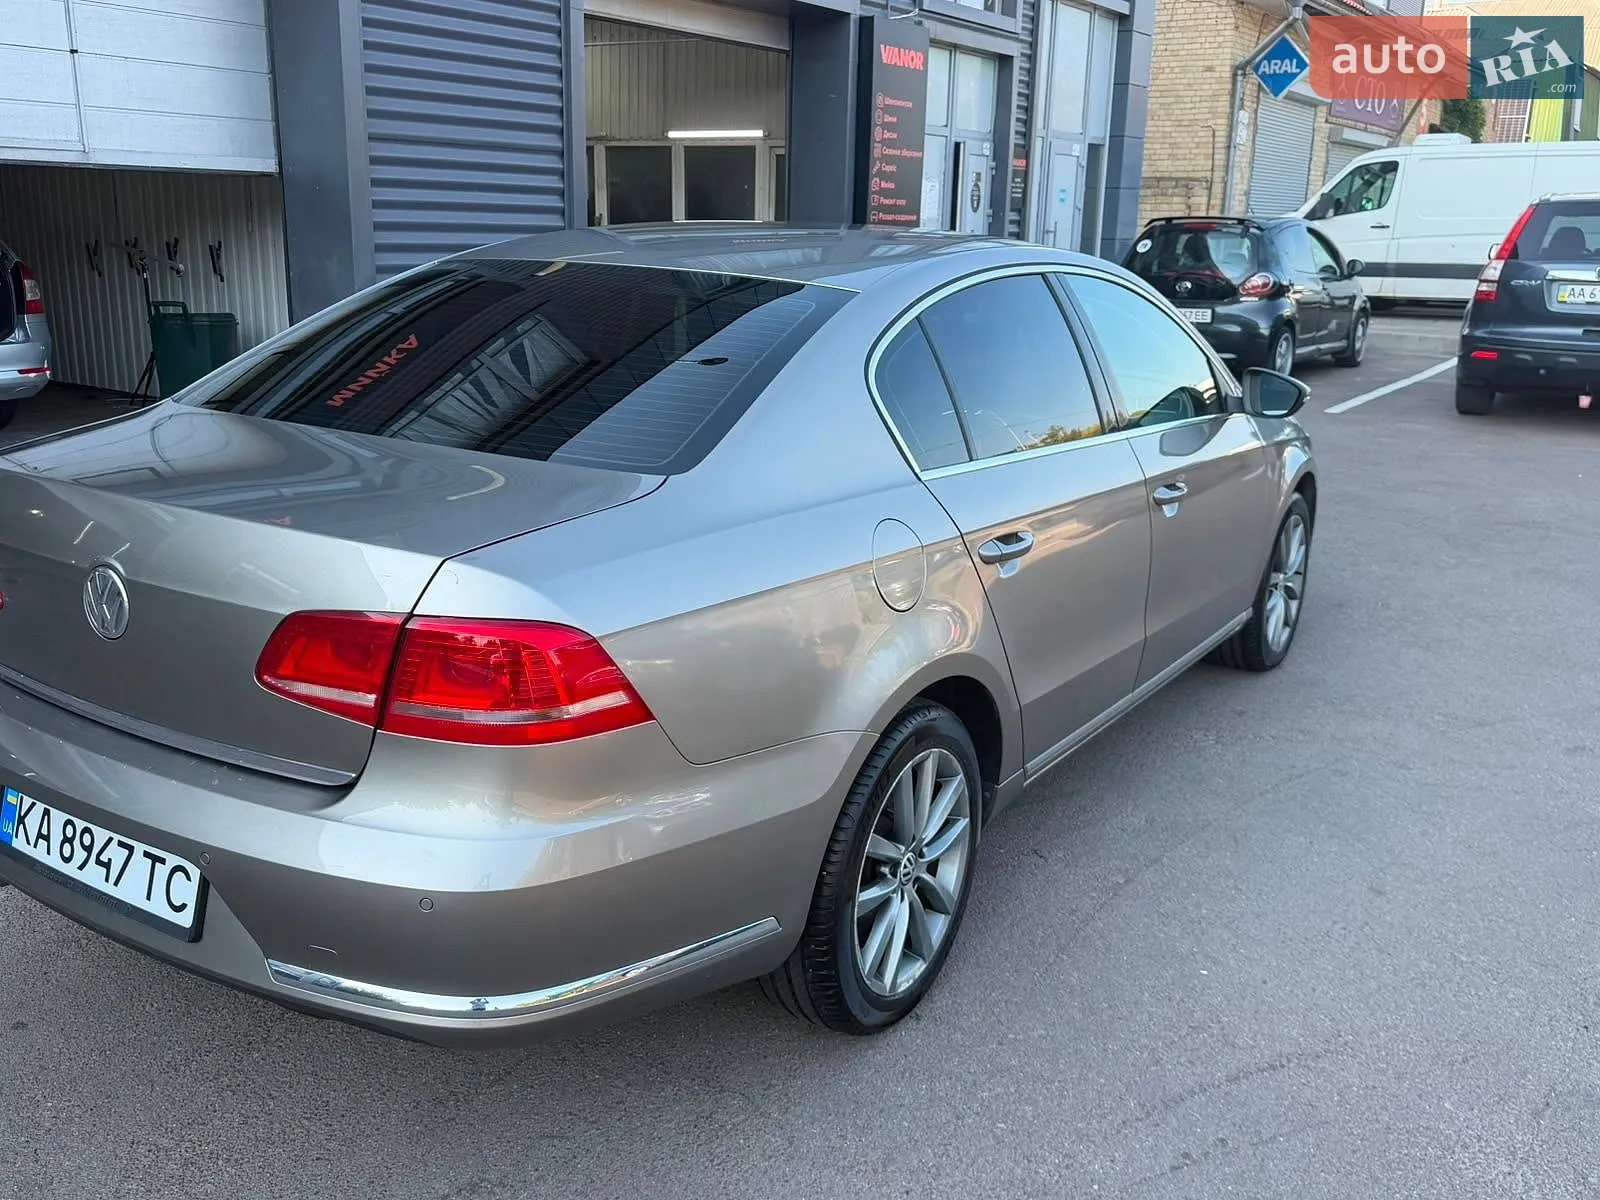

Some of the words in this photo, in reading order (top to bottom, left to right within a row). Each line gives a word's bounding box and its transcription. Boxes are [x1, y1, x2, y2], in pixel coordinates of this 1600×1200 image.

[1258, 58, 1301, 75] ARAL
[1567, 287, 1585, 299] AA
[1589, 287, 1600, 299] 6
[2, 818, 13, 835] UA
[14, 795, 52, 856] KA
[59, 818, 135, 888] 8947
[142, 850, 192, 913] TC
